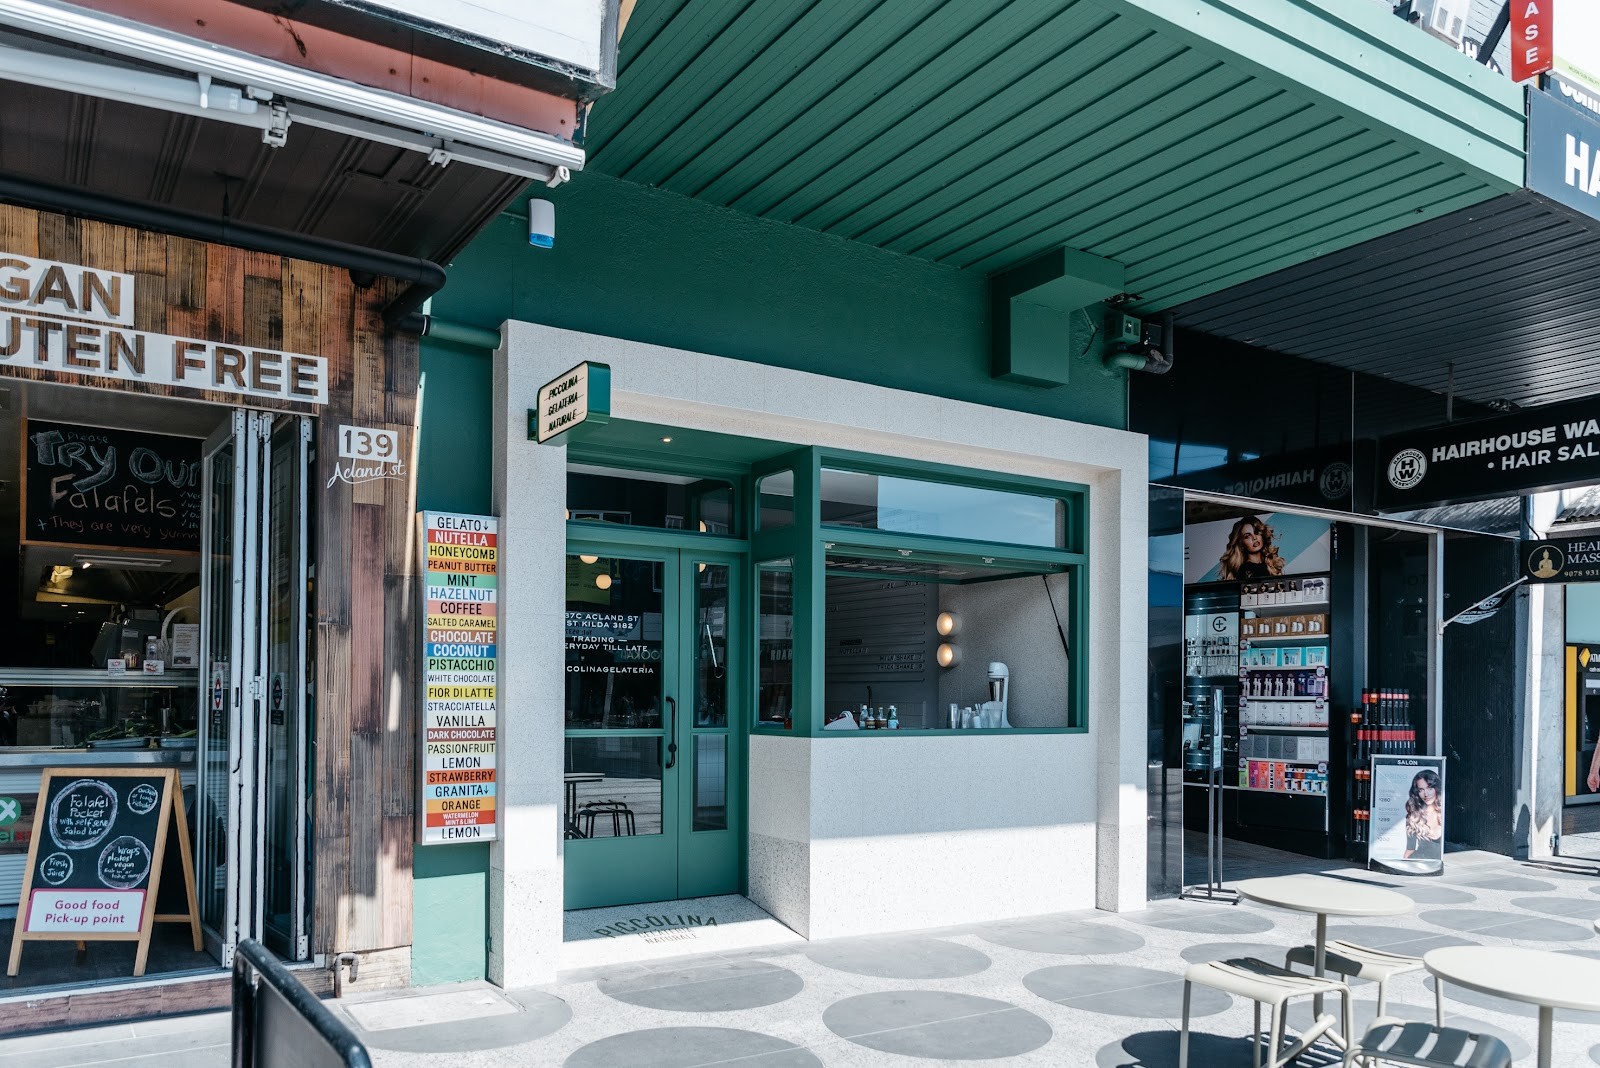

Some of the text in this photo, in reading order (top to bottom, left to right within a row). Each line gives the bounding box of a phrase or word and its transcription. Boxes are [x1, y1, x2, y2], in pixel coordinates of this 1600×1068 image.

[0, 258, 121, 317] GAN
[174, 340, 319, 397] FREE
[548, 374, 578, 400] PICCOLINA
[548, 391, 578, 416] GELATERIA
[548, 408, 577, 432] NATURALE
[67, 431, 109, 444] Please
[343, 429, 394, 458] 139
[1431, 426, 1556, 463] HAIRHOUSE
[1501, 441, 1600, 471] HAIR SAL
[327, 460, 387, 488] Acland
[51, 473, 176, 518] Falafels
[50, 516, 84, 533] They
[91, 520, 113, 531] are
[121, 523, 150, 538] very
[437, 516, 481, 532] GELATO
[435, 531, 489, 546] NUTELLA
[430, 545, 495, 560] HONEYCOMB
[428, 560, 496, 573] PEANUT BUTTER
[447, 574, 477, 586] MINT
[430, 587, 493, 601] HAZELNUT
[440, 602, 482, 615] COFFEE
[428, 618, 496, 628] SALTED CARAMEL
[585, 613, 624, 622] ACLAND
[581, 621, 610, 629] KILDA
[430, 630, 494, 643] CHOCOLATE
[571, 635, 615, 643] TRADING
[433, 643, 490, 657] COCONUT
[429, 659, 495, 671] PISTACCHIO
[428, 674, 495, 683] WHITE CHOCOLATE
[429, 687, 494, 698] FIOR DI LATTE
[427, 702, 496, 711] STRACCIATELLA
[436, 715, 486, 727] VANILLA
[428, 730, 495, 740] DARK CHOCOLATE
[428, 743, 495, 754] PASSIONFRUIT
[442, 757, 481, 769] LEMON
[429, 771, 494, 783] STRAWBERRY
[435, 785, 483, 798] GRANITA
[70, 794, 109, 808] Falafel
[441, 800, 480, 811] ORANGE
[69, 808, 104, 818] Pocket
[443, 811, 479, 819] WATERMELON
[445, 818, 459, 826] MINT
[88, 827, 102, 836] bar
[442, 826, 480, 839] LEMON
[49, 858, 68, 868] Fresh
[114, 862, 135, 871] vegan
[47, 868, 65, 878] Juice
[54, 900, 119, 910] Good food
[45, 913, 125, 925] Pick-up point
[594, 914, 718, 938] PICCOLINA
